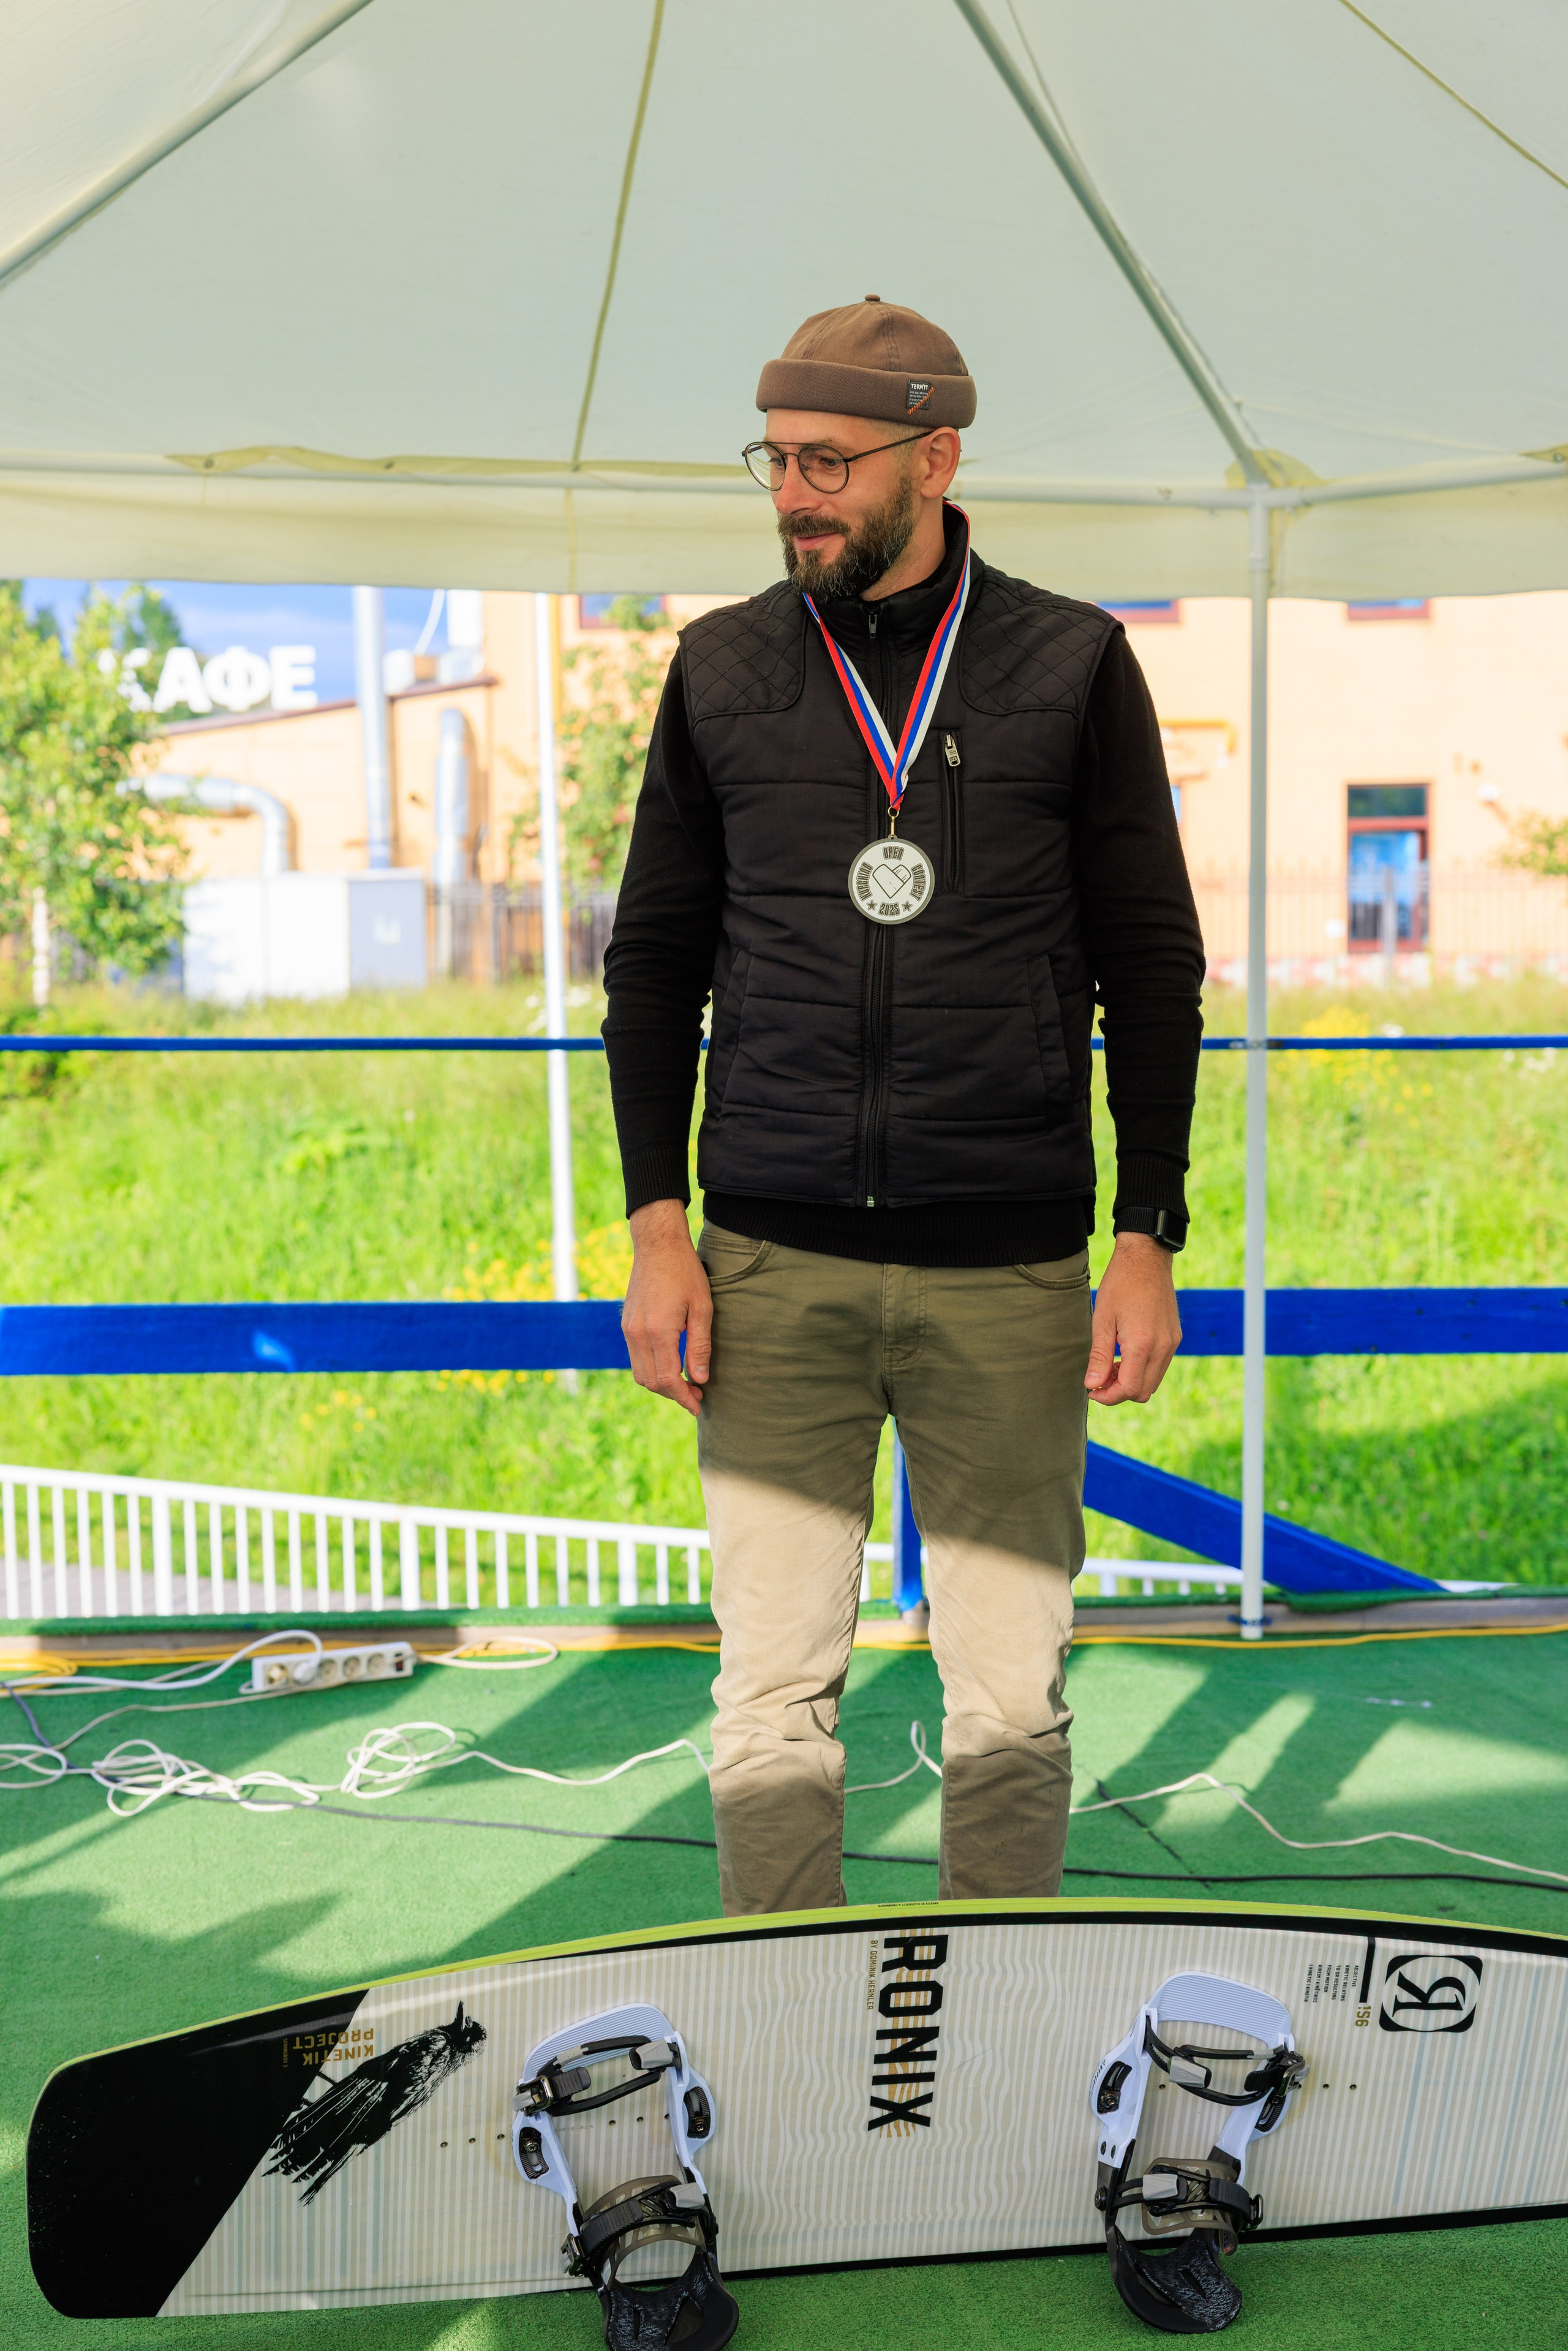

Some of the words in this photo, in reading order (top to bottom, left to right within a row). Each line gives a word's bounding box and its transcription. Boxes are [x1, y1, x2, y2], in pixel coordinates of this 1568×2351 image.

[857, 862, 872, 900] KUPCHINO
[883, 847, 904, 860] OPEN
[911, 864, 925, 901] CONTEST
[879, 903, 900, 916] 2025
[871, 1940, 878, 1949] BY
[869, 1950, 878, 1979] DOMINIK
[867, 1980, 875, 2010] HERNLER
[1355, 2006, 1371, 2027] 156
[293, 2028, 374, 2049] PROJECT
[868, 1934, 949, 2132] RONIX
[303, 2045, 374, 2066] KINETIK
